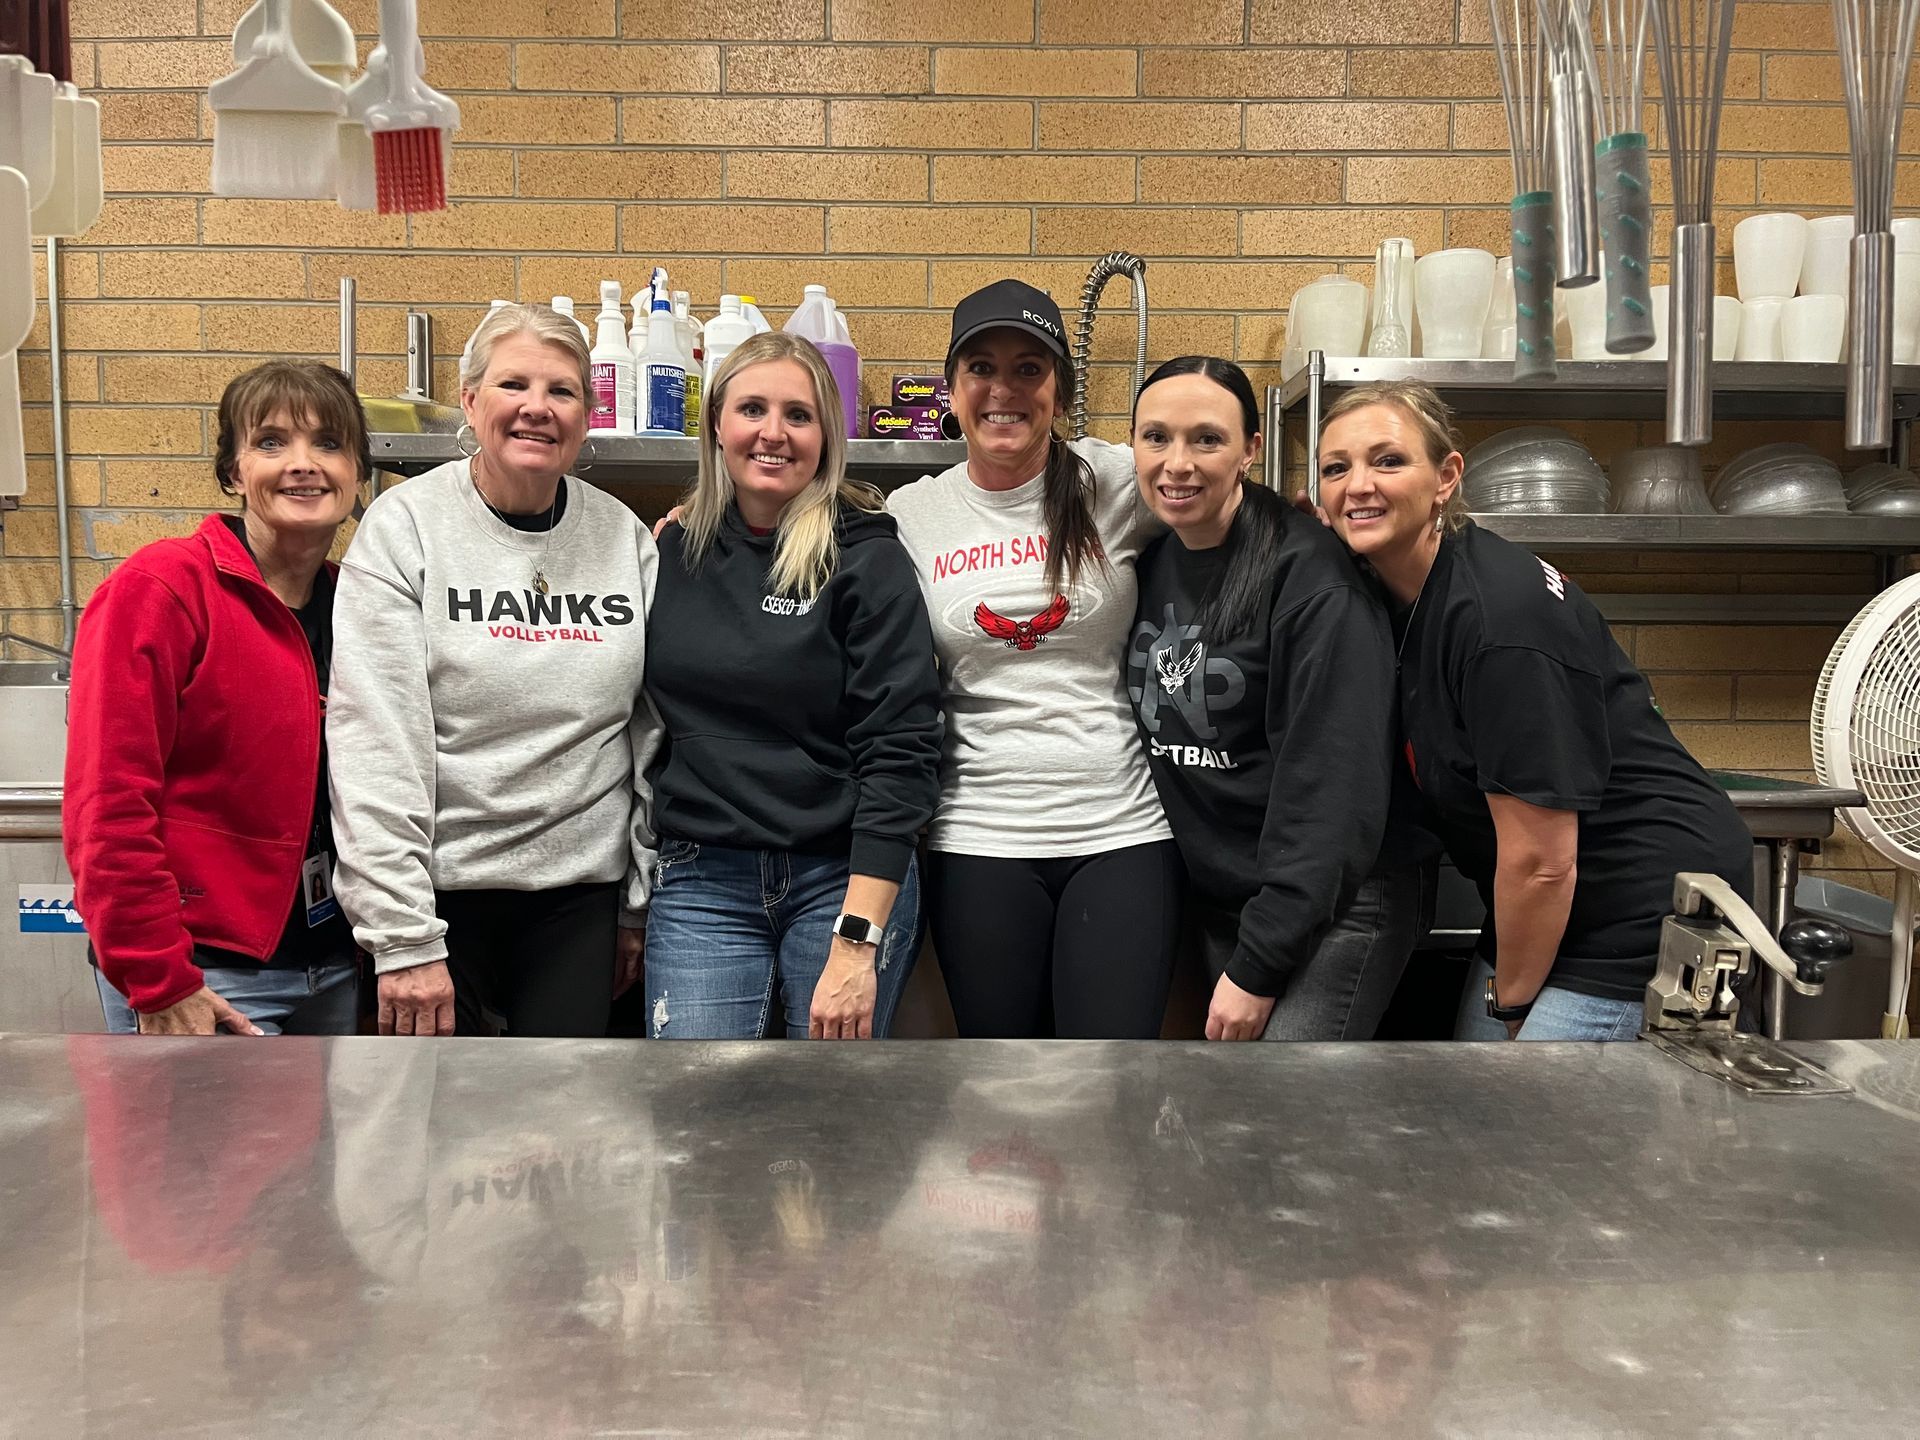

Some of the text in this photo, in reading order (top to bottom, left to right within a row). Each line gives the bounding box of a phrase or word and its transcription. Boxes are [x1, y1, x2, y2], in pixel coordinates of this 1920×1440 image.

[1022, 309, 1060, 337] ROXY
[592, 366, 613, 377] LIANT
[899, 385, 935, 394] JobSelect
[876, 417, 913, 426] JobSelect
[912, 425, 939, 434] Synthetic
[933, 541, 1004, 584] NORTH
[447, 587, 635, 627] HAWKS
[487, 626, 604, 643] VOLLEYBALL
